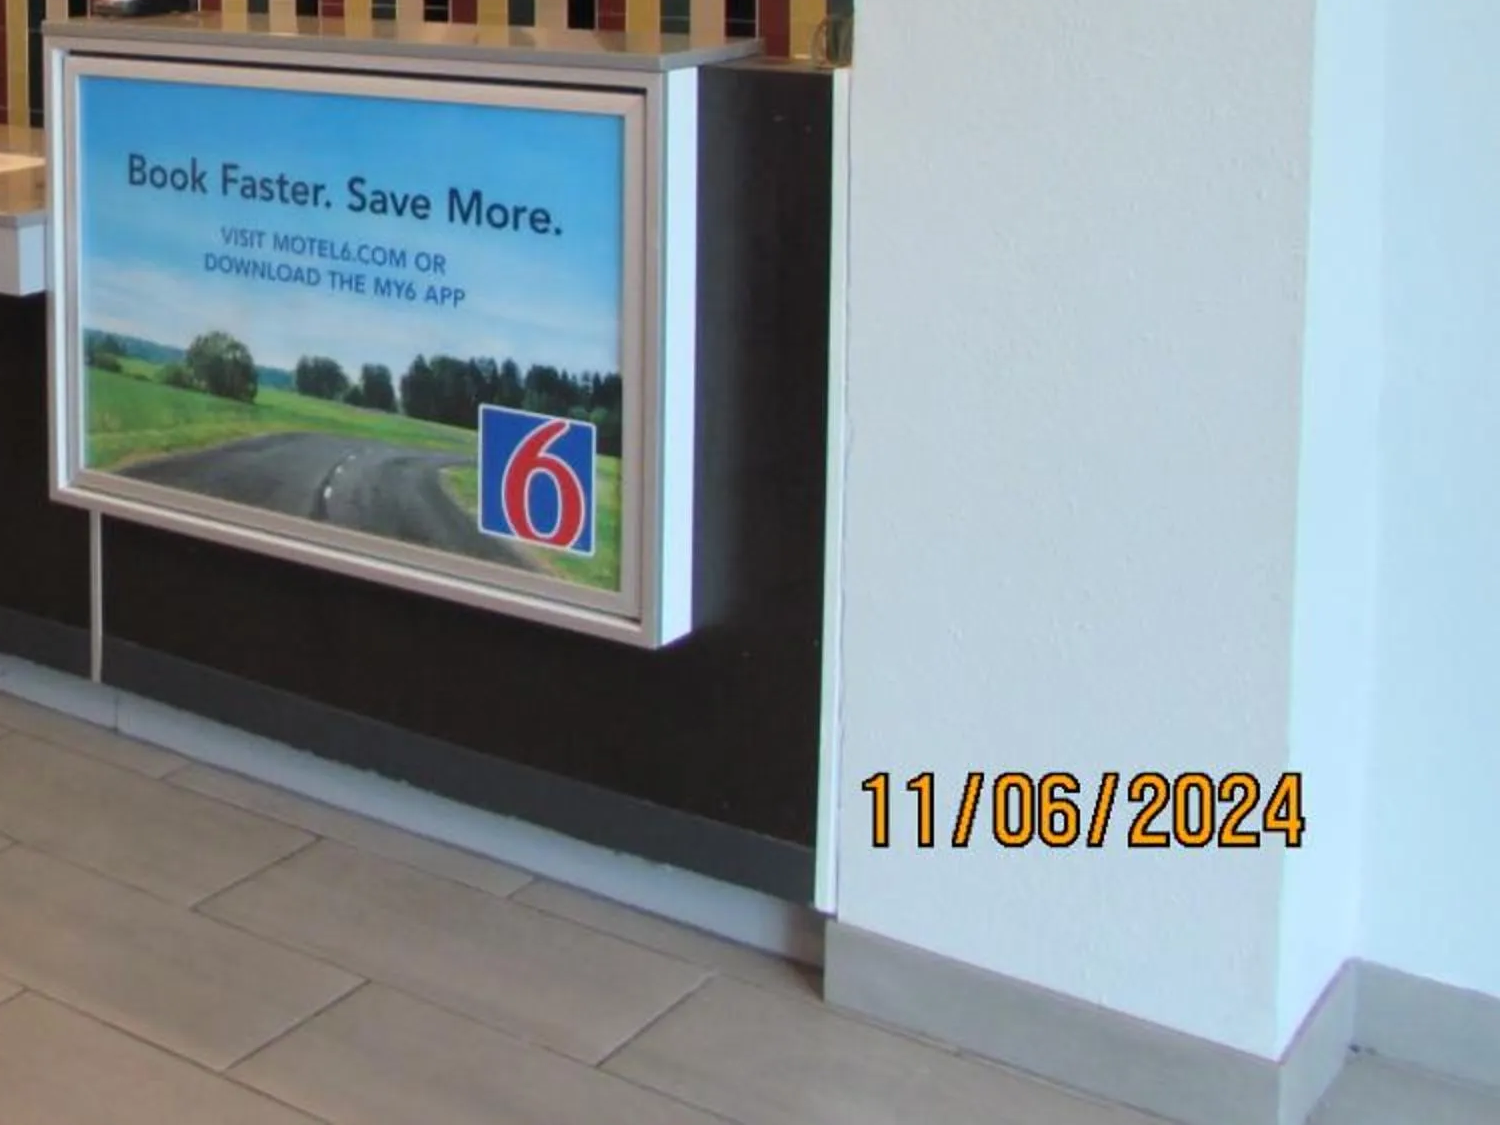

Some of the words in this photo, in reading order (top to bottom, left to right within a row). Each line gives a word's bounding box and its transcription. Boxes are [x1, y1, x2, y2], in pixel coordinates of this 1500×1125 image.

[127, 153, 208, 195] Book
[221, 163, 333, 209] Faster.
[347, 176, 432, 220] Save
[447, 187, 563, 237] More.
[203, 252, 322, 287] DOWNLOAD
[327, 270, 366, 295] THE
[373, 277, 417, 302] MY6
[423, 285, 466, 309] APP
[220, 227, 267, 248] VISIT
[273, 231, 407, 269] MOTEL6.COM
[414, 252, 447, 275] OR
[502, 418, 585, 551] 6
